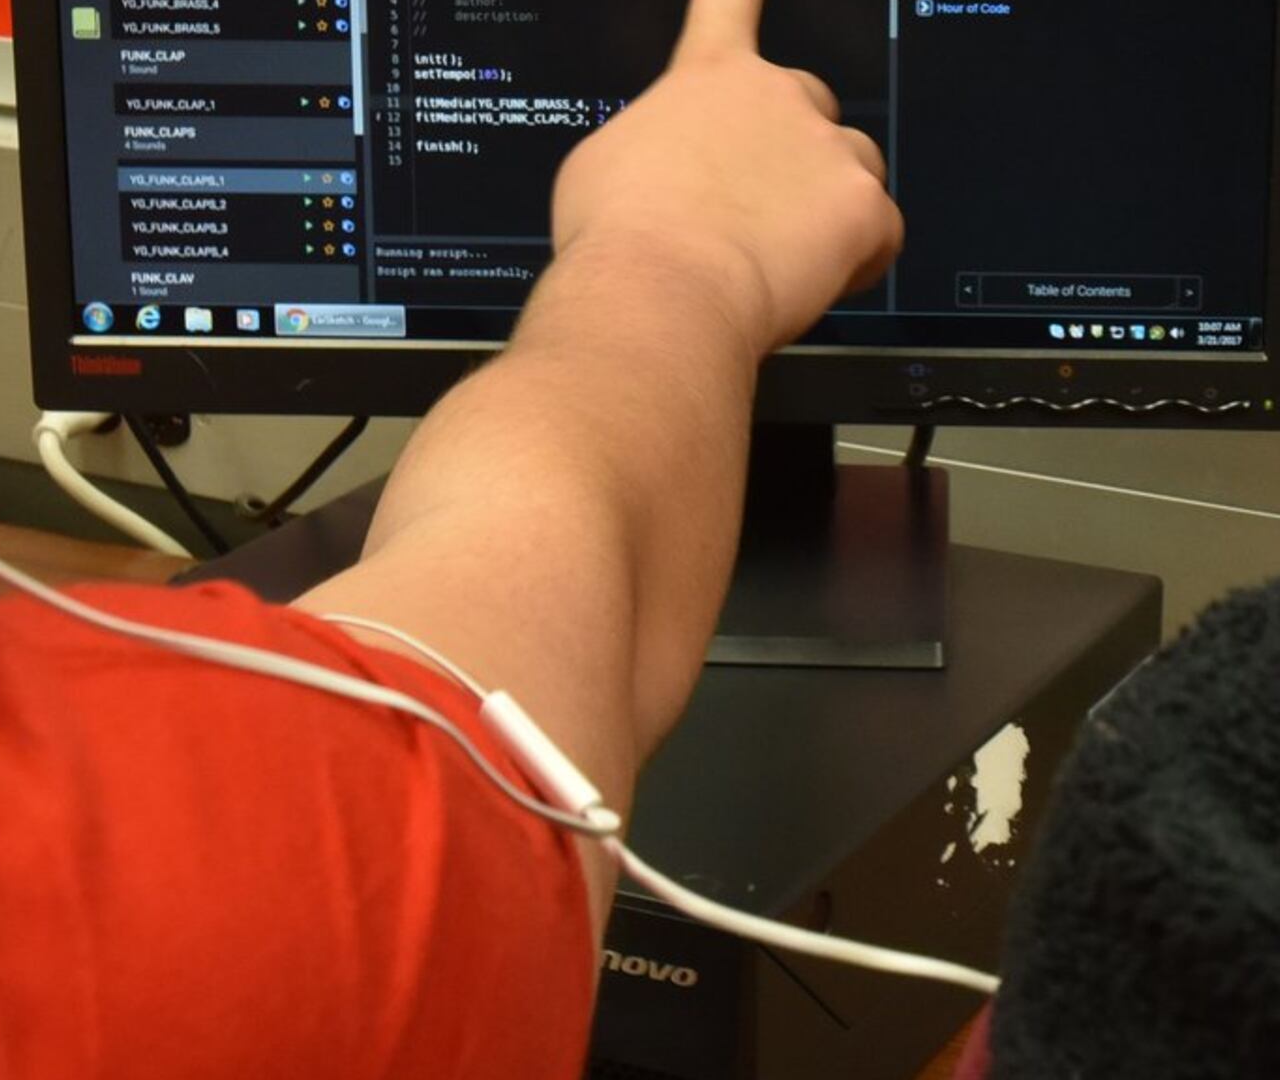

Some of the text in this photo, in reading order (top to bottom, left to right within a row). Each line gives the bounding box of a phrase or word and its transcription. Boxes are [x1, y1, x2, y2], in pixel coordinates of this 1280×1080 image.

[937, 2, 1010, 14] Hour of Code
[455, 10, 540, 22] description:
[120, 50, 186, 62] FUNK_CLAP
[126, 99, 216, 112] YG_FUNK_CLAP_1
[124, 126, 196, 138] FUNK_CLAPS
[131, 198, 226, 211] YG_FUNK_CLAPS_2
[132, 222, 228, 234] YG_FUNK_CLAPS_3
[133, 246, 229, 258] YG_FUNK_CLAPS_4
[376, 246, 423, 260] Running
[131, 272, 194, 284] FUNK_CLAV
[378, 266, 534, 280] Script ran successfully.
[1028, 284, 1132, 298] Table of Contents
[601, 949, 698, 986] novo
